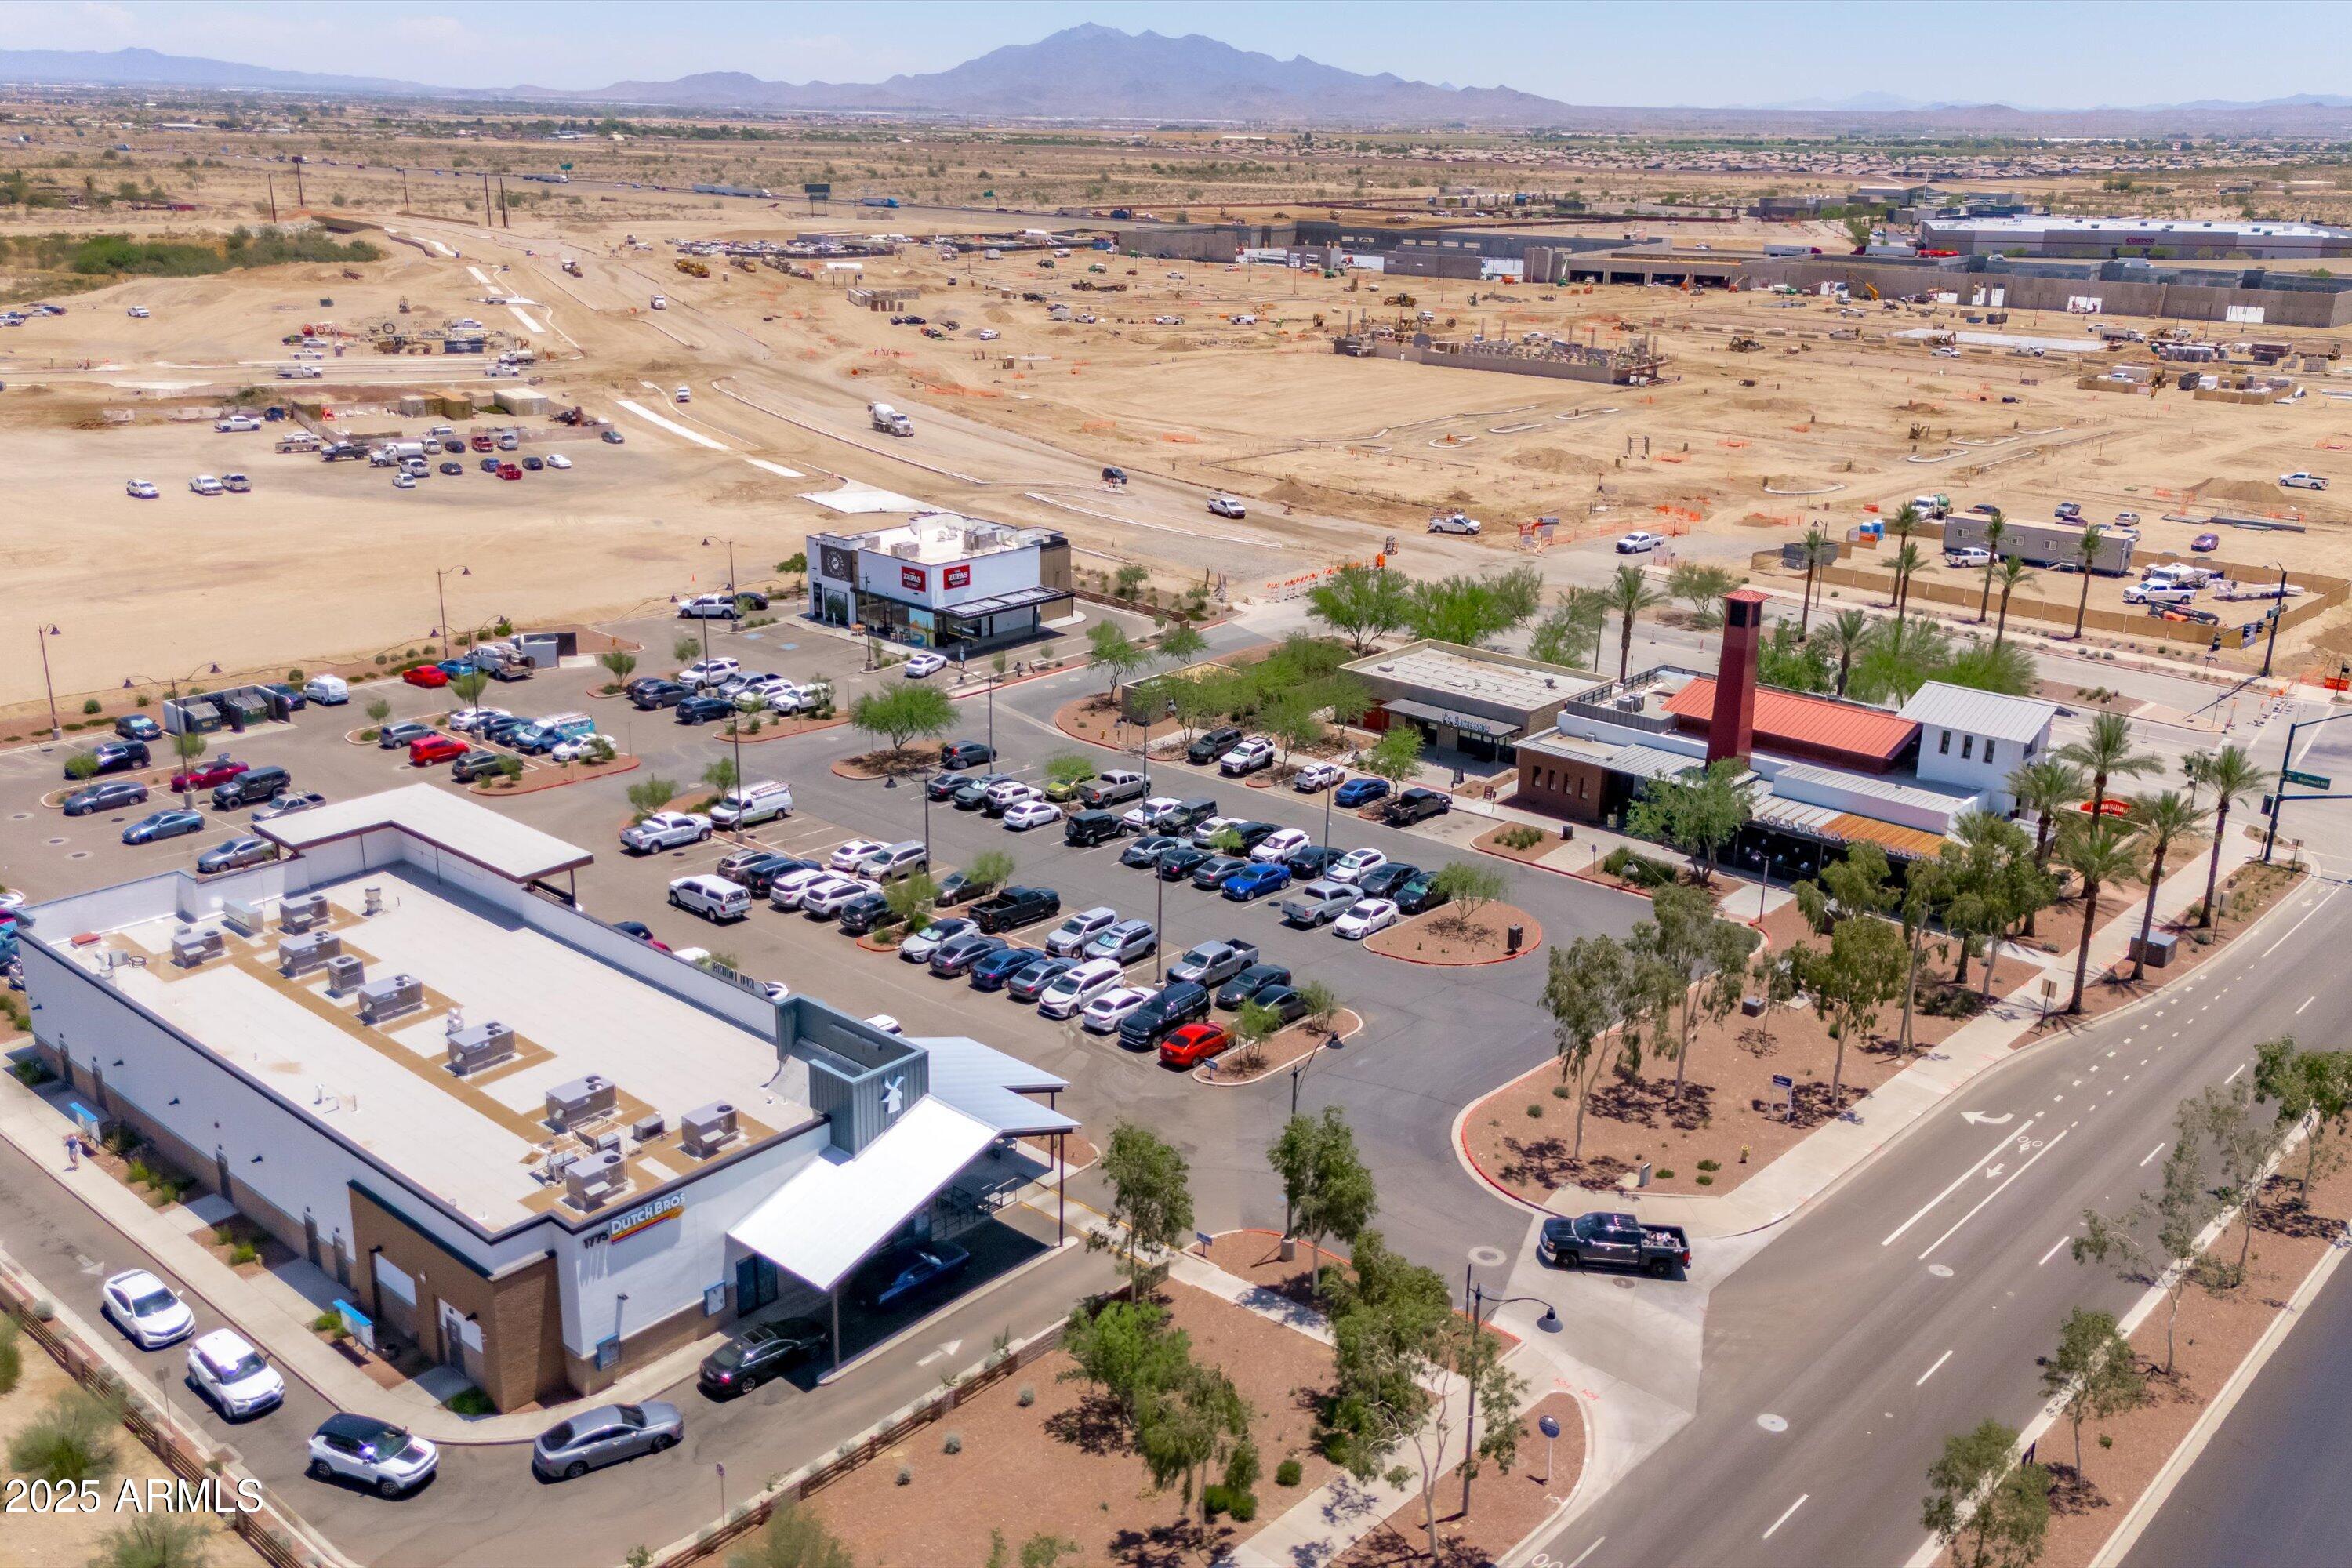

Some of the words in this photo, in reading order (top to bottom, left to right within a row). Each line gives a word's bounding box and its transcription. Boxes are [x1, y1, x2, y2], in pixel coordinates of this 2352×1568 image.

[903, 573, 922, 584] ZUPAS
[948, 571, 968, 582] ZUPAS
[1759, 813, 1794, 831] COLD
[1797, 822, 1841, 842] BEERS
[583, 1229, 609, 1249] 1775
[612, 1206, 653, 1235] DUTCH
[654, 1192, 686, 1215] BROS
